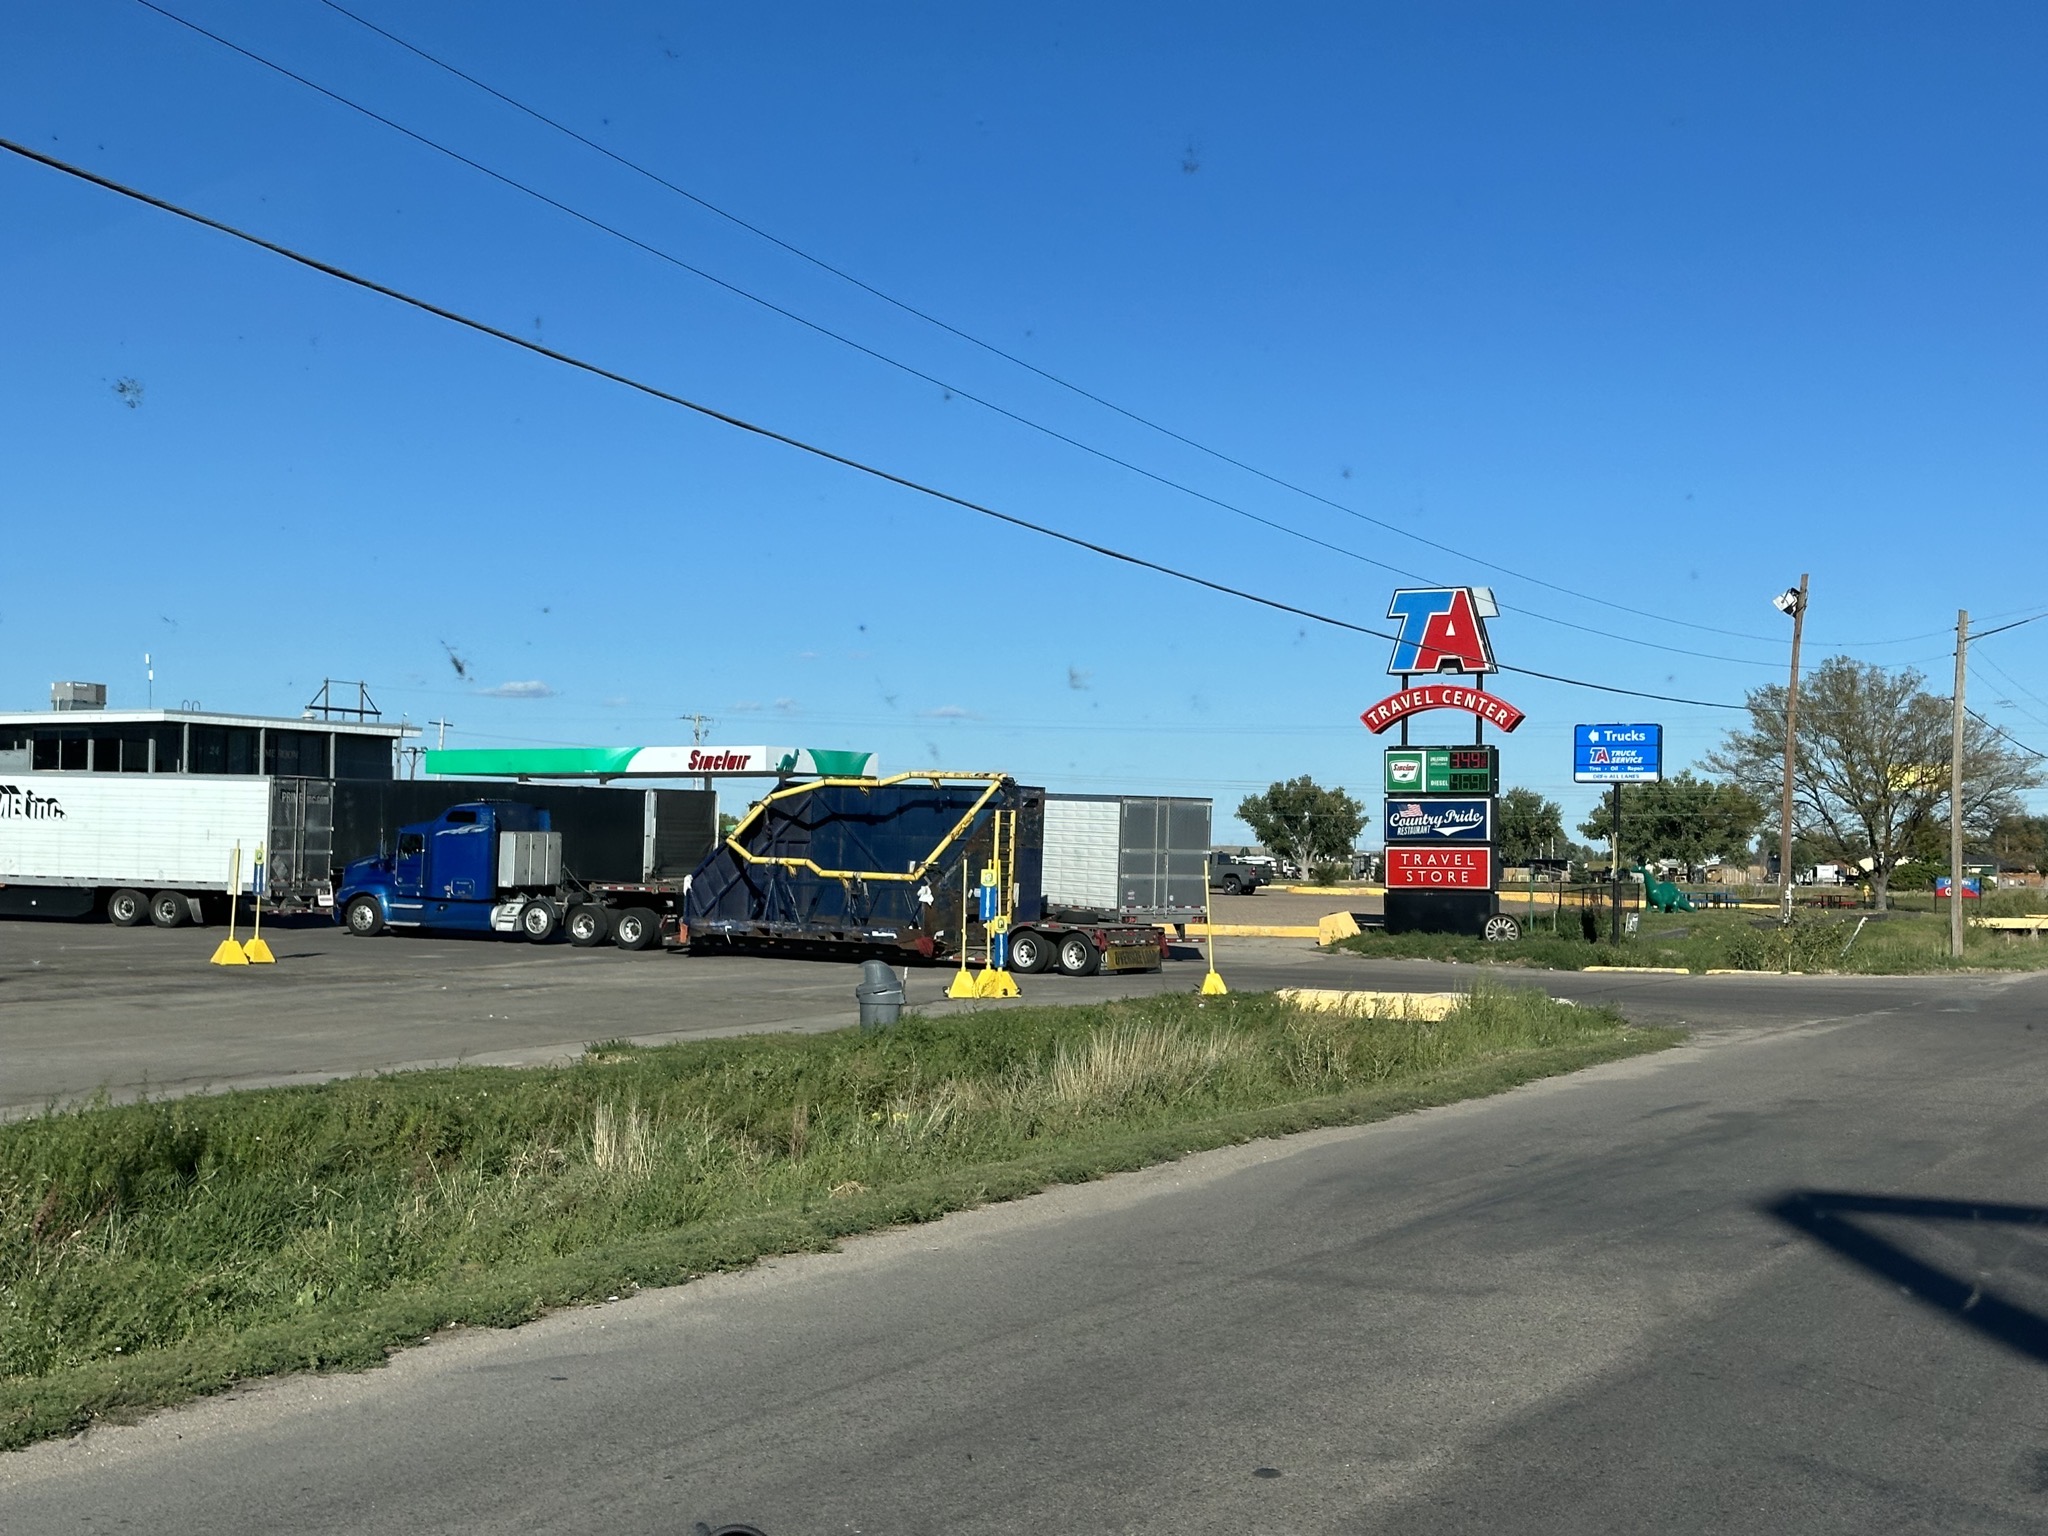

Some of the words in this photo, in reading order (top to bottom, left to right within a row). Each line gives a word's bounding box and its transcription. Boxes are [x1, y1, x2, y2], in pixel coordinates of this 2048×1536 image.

[1388, 588, 1489, 673] TA
[1367, 689, 1434, 725] TRAVEL
[1442, 689, 1508, 725] CENTER
[1603, 729, 1646, 742] Trucks
[688, 749, 752, 771] Sinclair
[1589, 747, 1610, 764] TA
[1627, 765, 1645, 773] Repair
[25, 790, 68, 822] inc.
[1389, 812, 1443, 829] Country
[1444, 808, 1482, 824] Pride
[1397, 825, 1432, 836] RESTAURANT
[1400, 853, 1475, 866] TRAVEL
[1406, 870, 1469, 883] STORE
